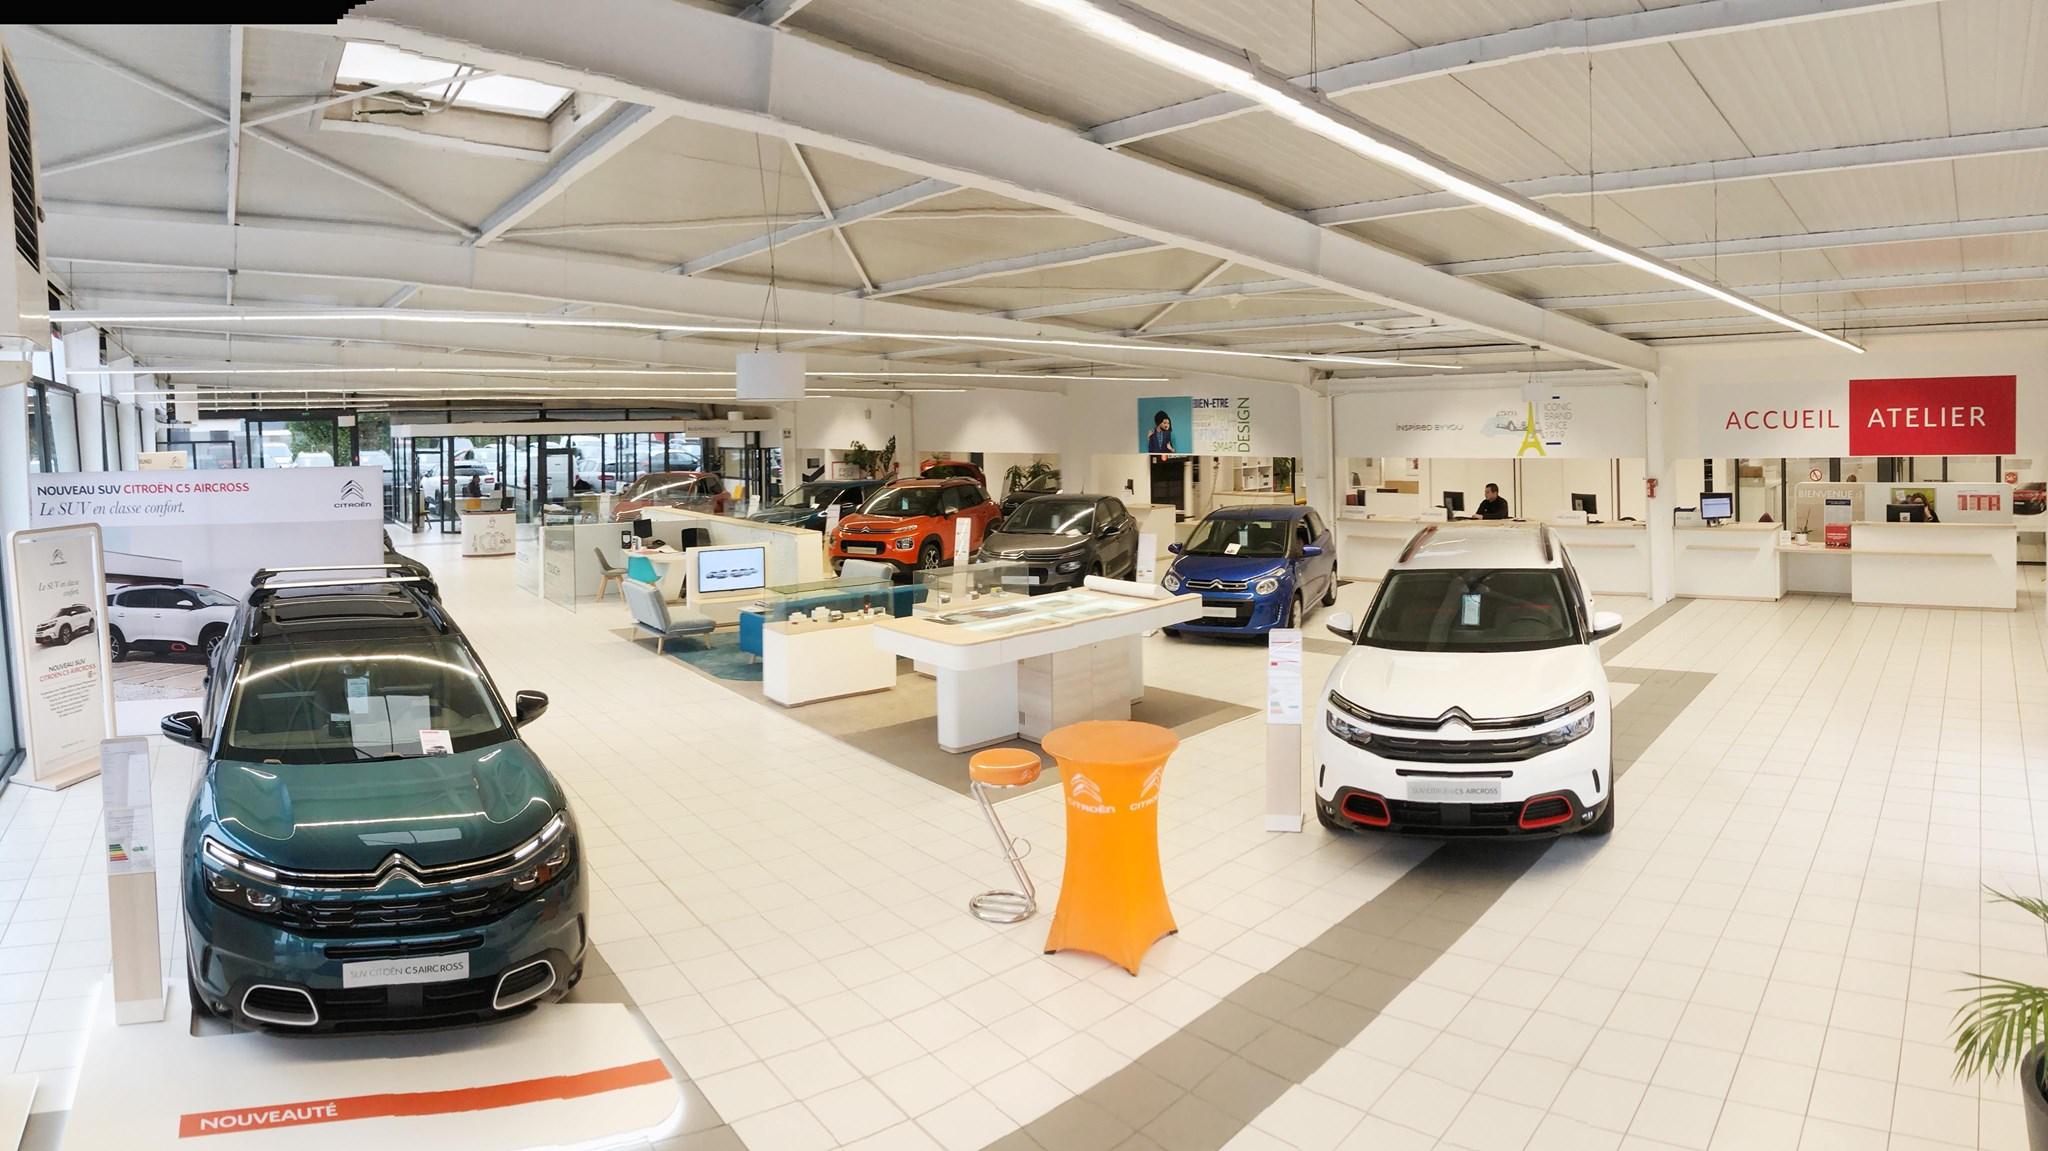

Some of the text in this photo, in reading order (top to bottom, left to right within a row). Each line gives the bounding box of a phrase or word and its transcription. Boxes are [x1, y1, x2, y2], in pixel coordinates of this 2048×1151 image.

[1544, 402, 1571, 411] ICONIC
[1237, 397, 1250, 452] DESIGN
[1725, 409, 1840, 430] ACCUEIL
[1867, 406, 1986, 428] ATELIER
[37, 482, 250, 496] NOUVEAU SUV CITROËN C5 AIRCROSS
[40, 500, 185, 517] Le SUV en classe confort.
[333, 501, 372, 509] CITROËN
[200, 1103, 339, 1131] NOUVEAUTÉ
